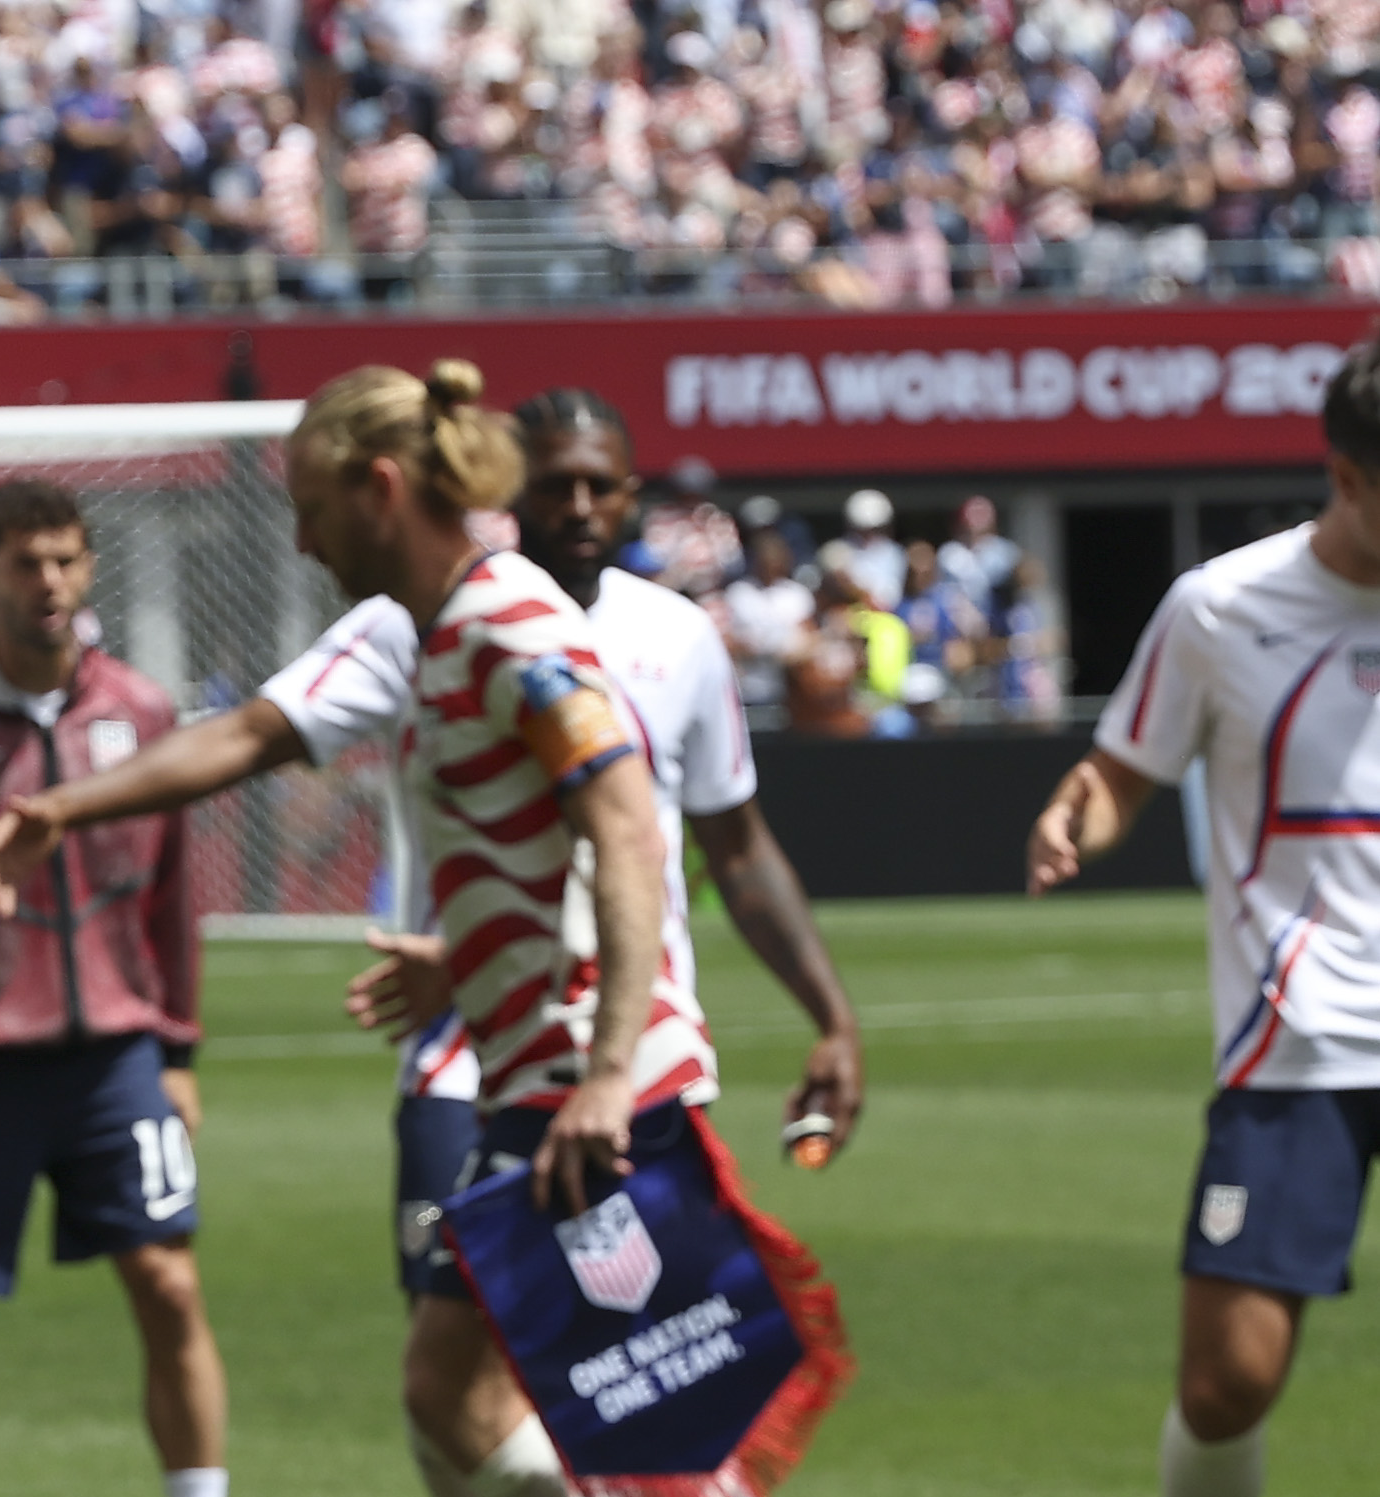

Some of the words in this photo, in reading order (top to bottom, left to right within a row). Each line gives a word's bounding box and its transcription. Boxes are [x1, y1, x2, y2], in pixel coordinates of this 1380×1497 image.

[665, 353, 825, 428] FIFA
[821, 348, 1078, 424] WORLD
[1080, 344, 1221, 420] CUP
[1222, 341, 1348, 418] 20
[130, 1115, 198, 1199] 10
[568, 1343, 634, 1399] ONE
[625, 1292, 742, 1368] NATION.
[594, 1368, 661, 1424] ONE
[650, 1328, 746, 1394] TEAM.
